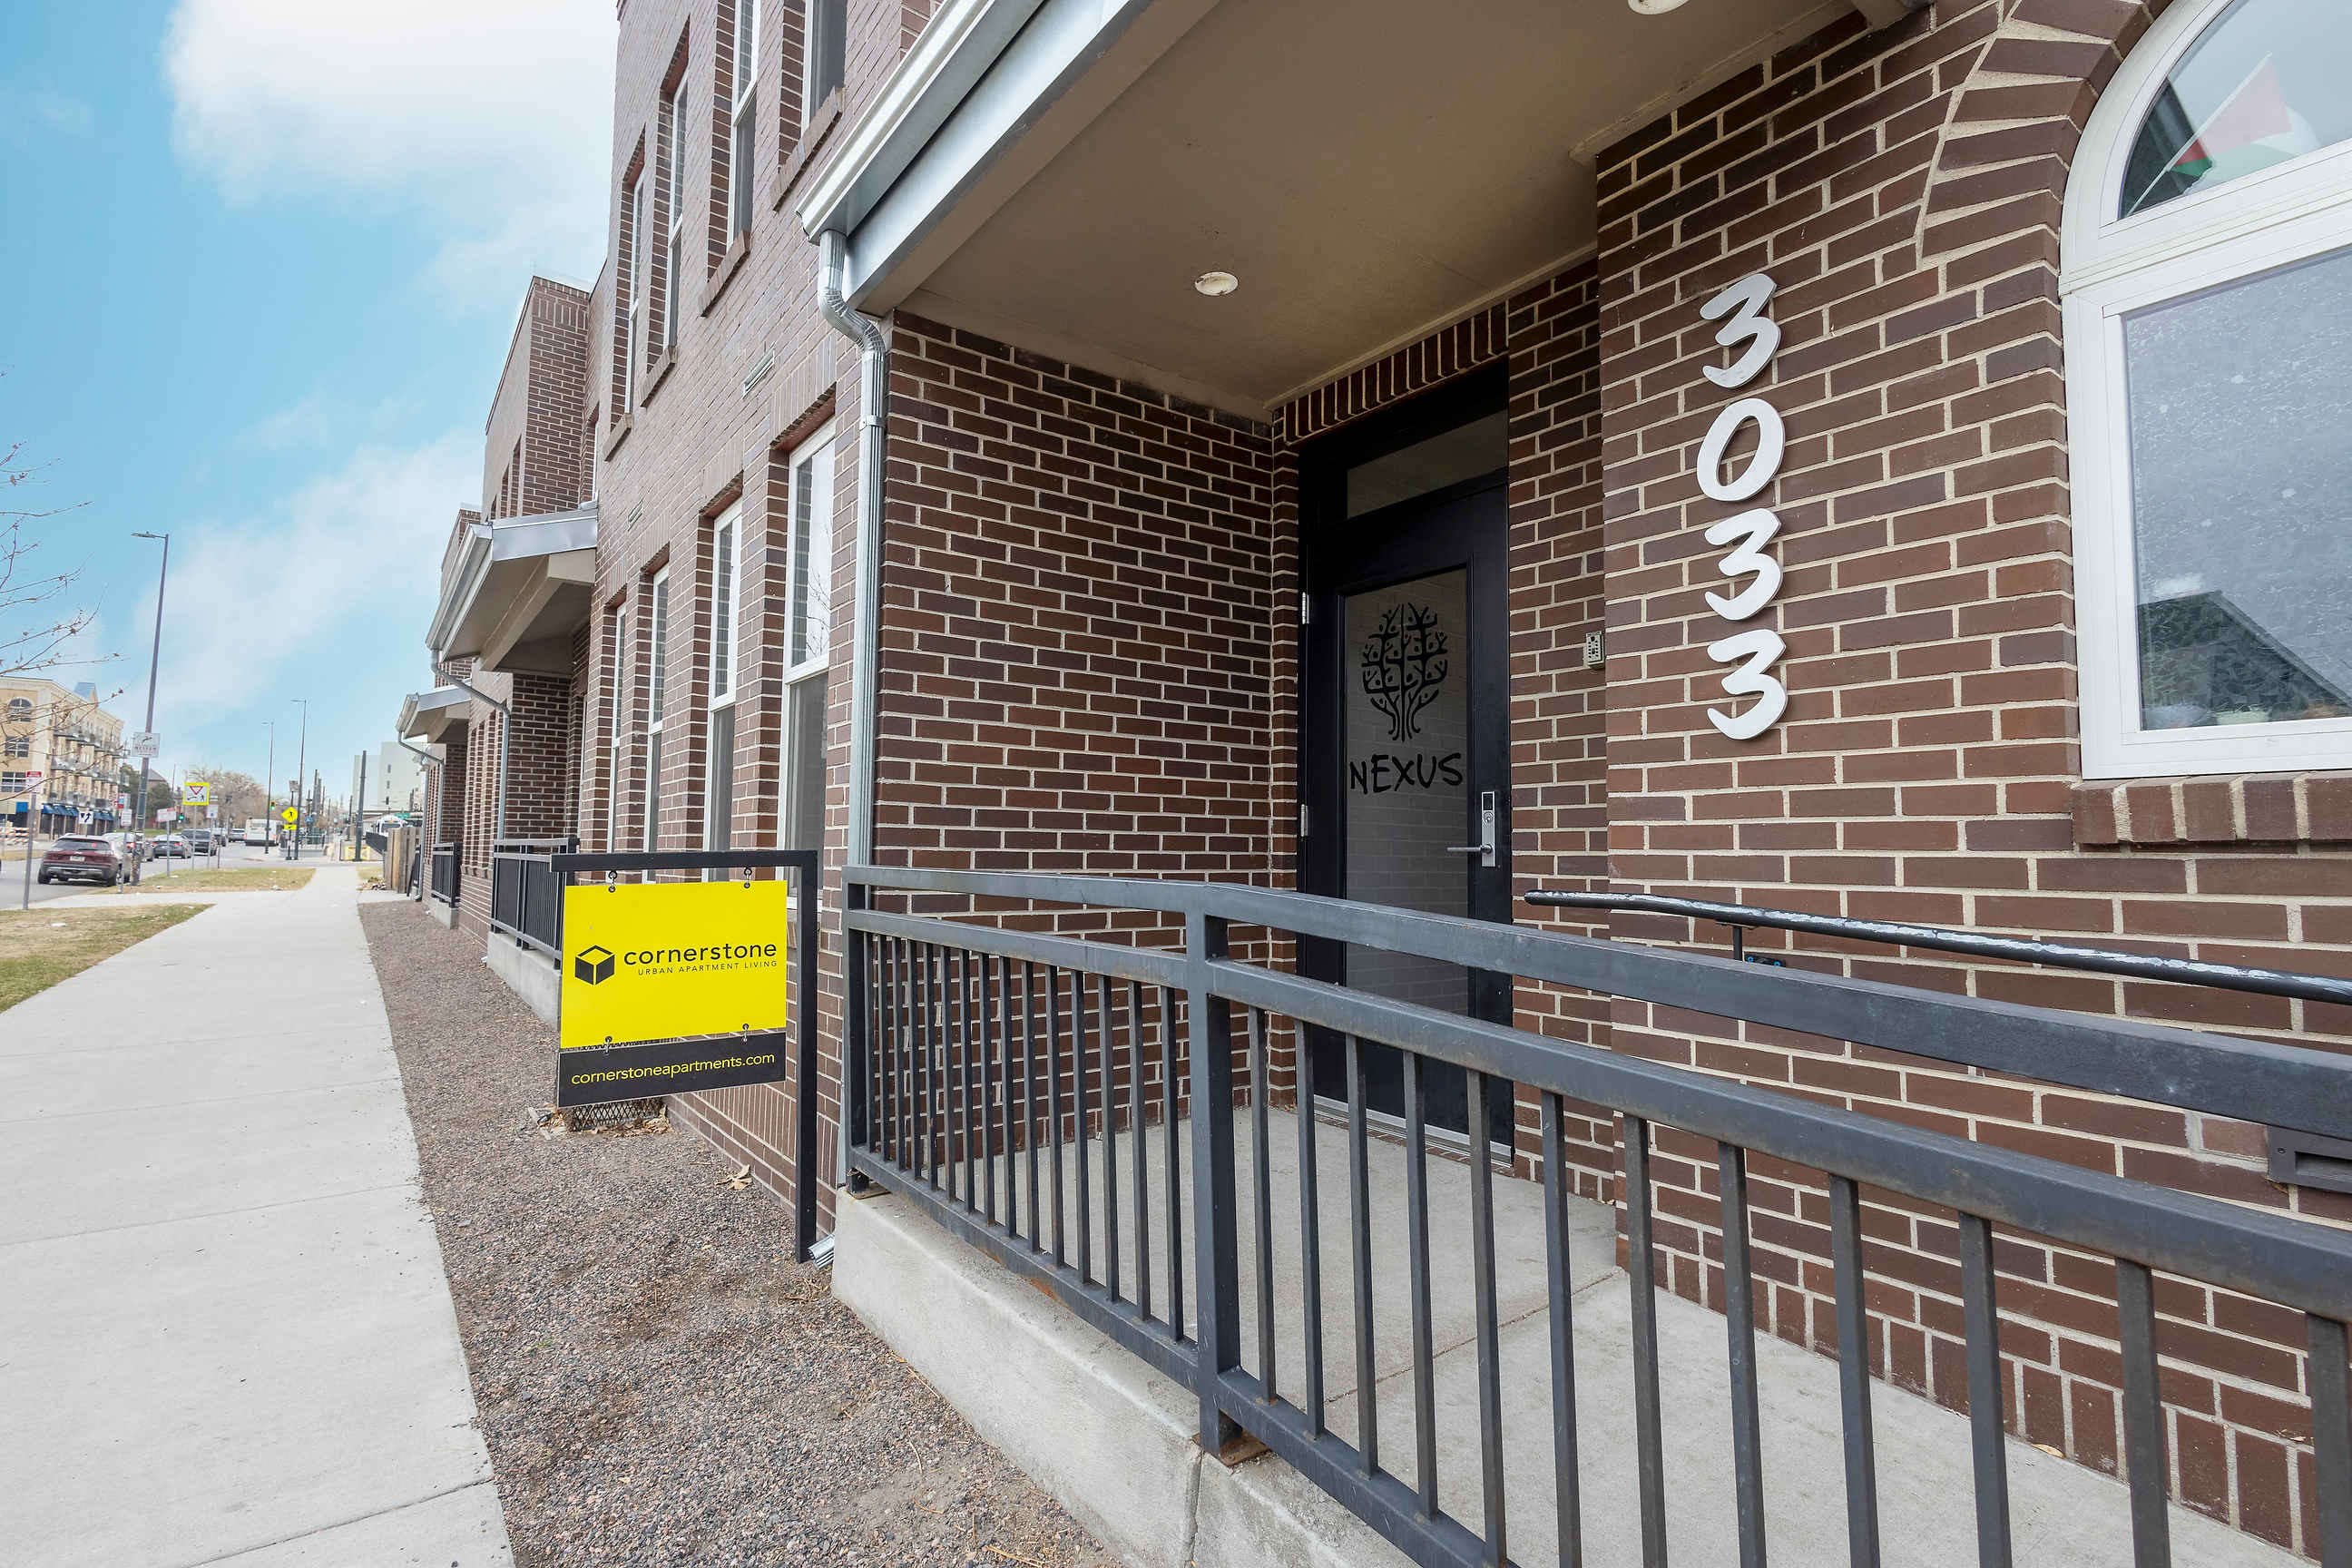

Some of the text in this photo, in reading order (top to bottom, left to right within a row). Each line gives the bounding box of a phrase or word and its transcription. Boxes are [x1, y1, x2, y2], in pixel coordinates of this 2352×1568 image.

[1697, 273, 1788, 740] 3033
[1349, 752, 1464, 794] NEXUS
[623, 943, 777, 965] cornerstone
[638, 960, 778, 976] URBAN APARTMENT LIVING
[571, 1053, 775, 1085] cornerstoneapartments.com
